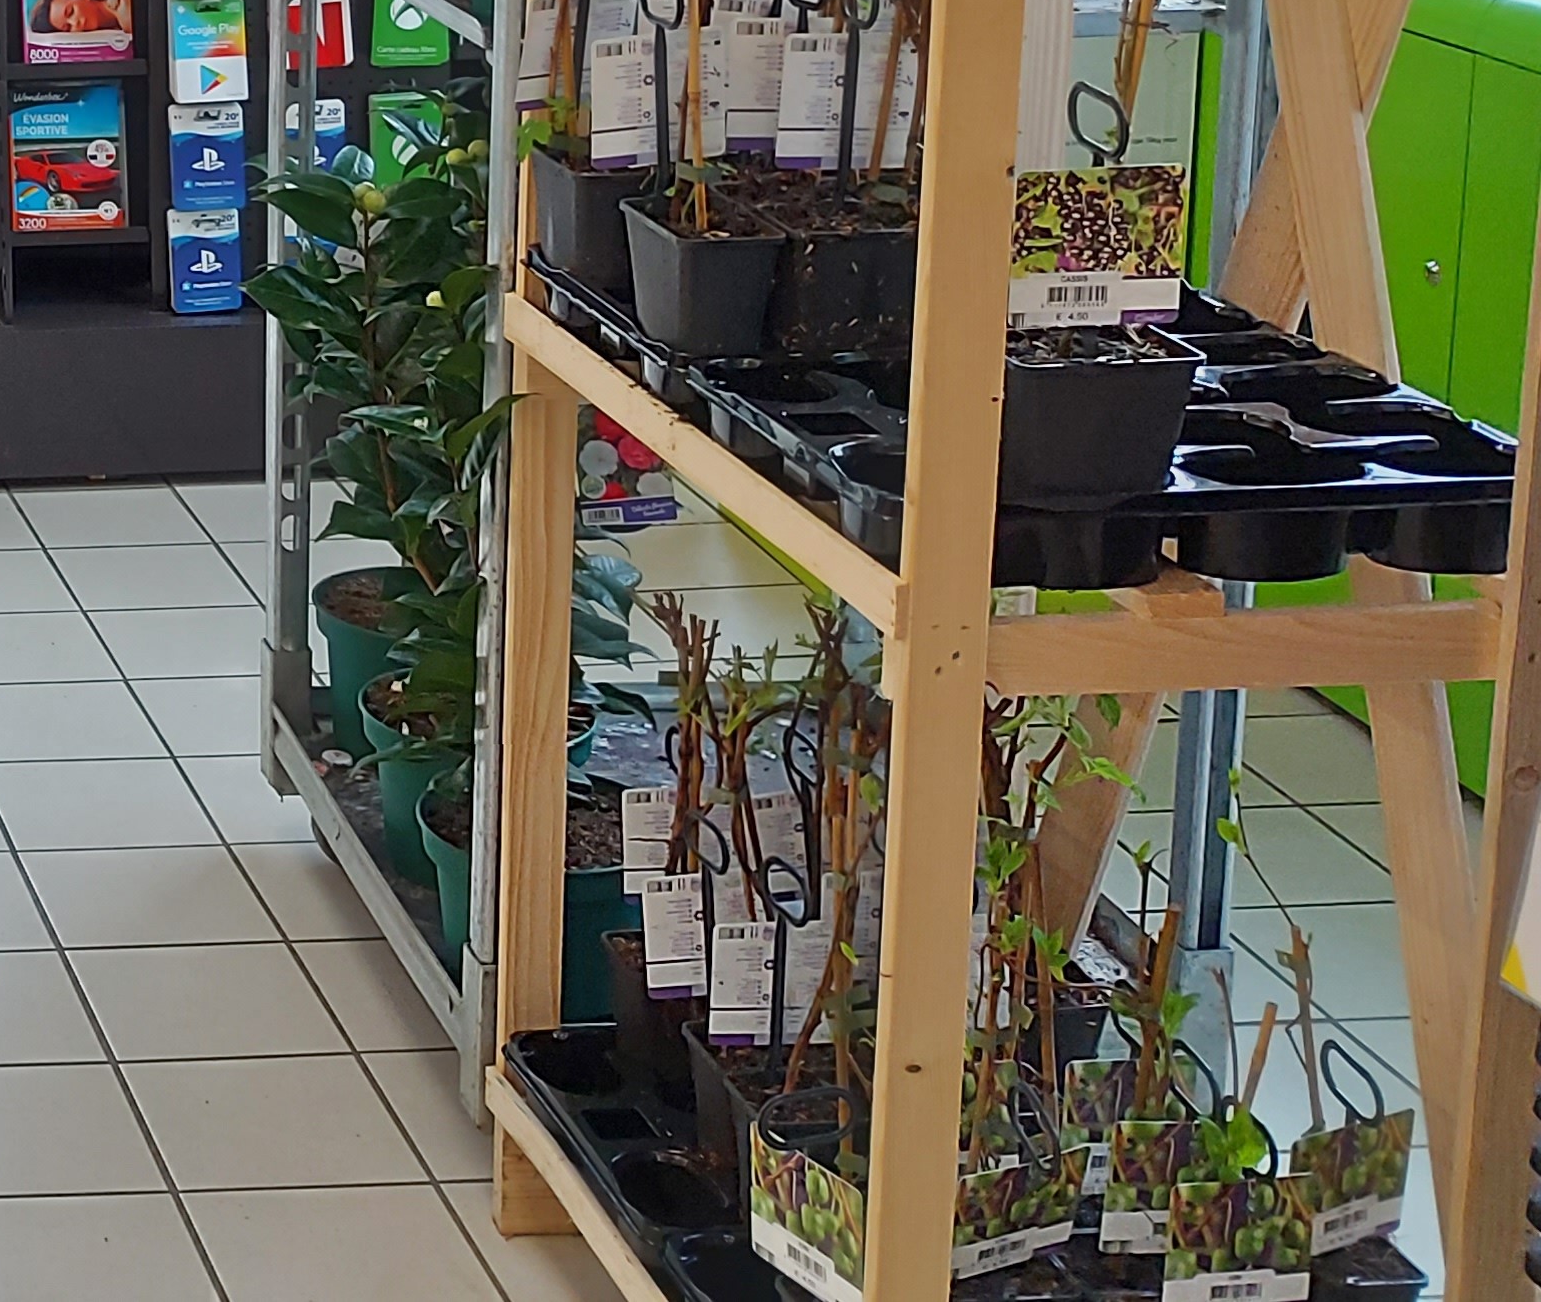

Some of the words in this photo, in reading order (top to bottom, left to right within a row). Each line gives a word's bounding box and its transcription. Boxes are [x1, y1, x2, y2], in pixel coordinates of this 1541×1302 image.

[178, 25, 217, 37] Google
[218, 23, 240, 34] Play
[29, 48, 59, 60] 8000
[23, 112, 69, 124] ÉVASION
[15, 125, 68, 136] SPORTIVE
[18, 218, 47, 230] 3200
